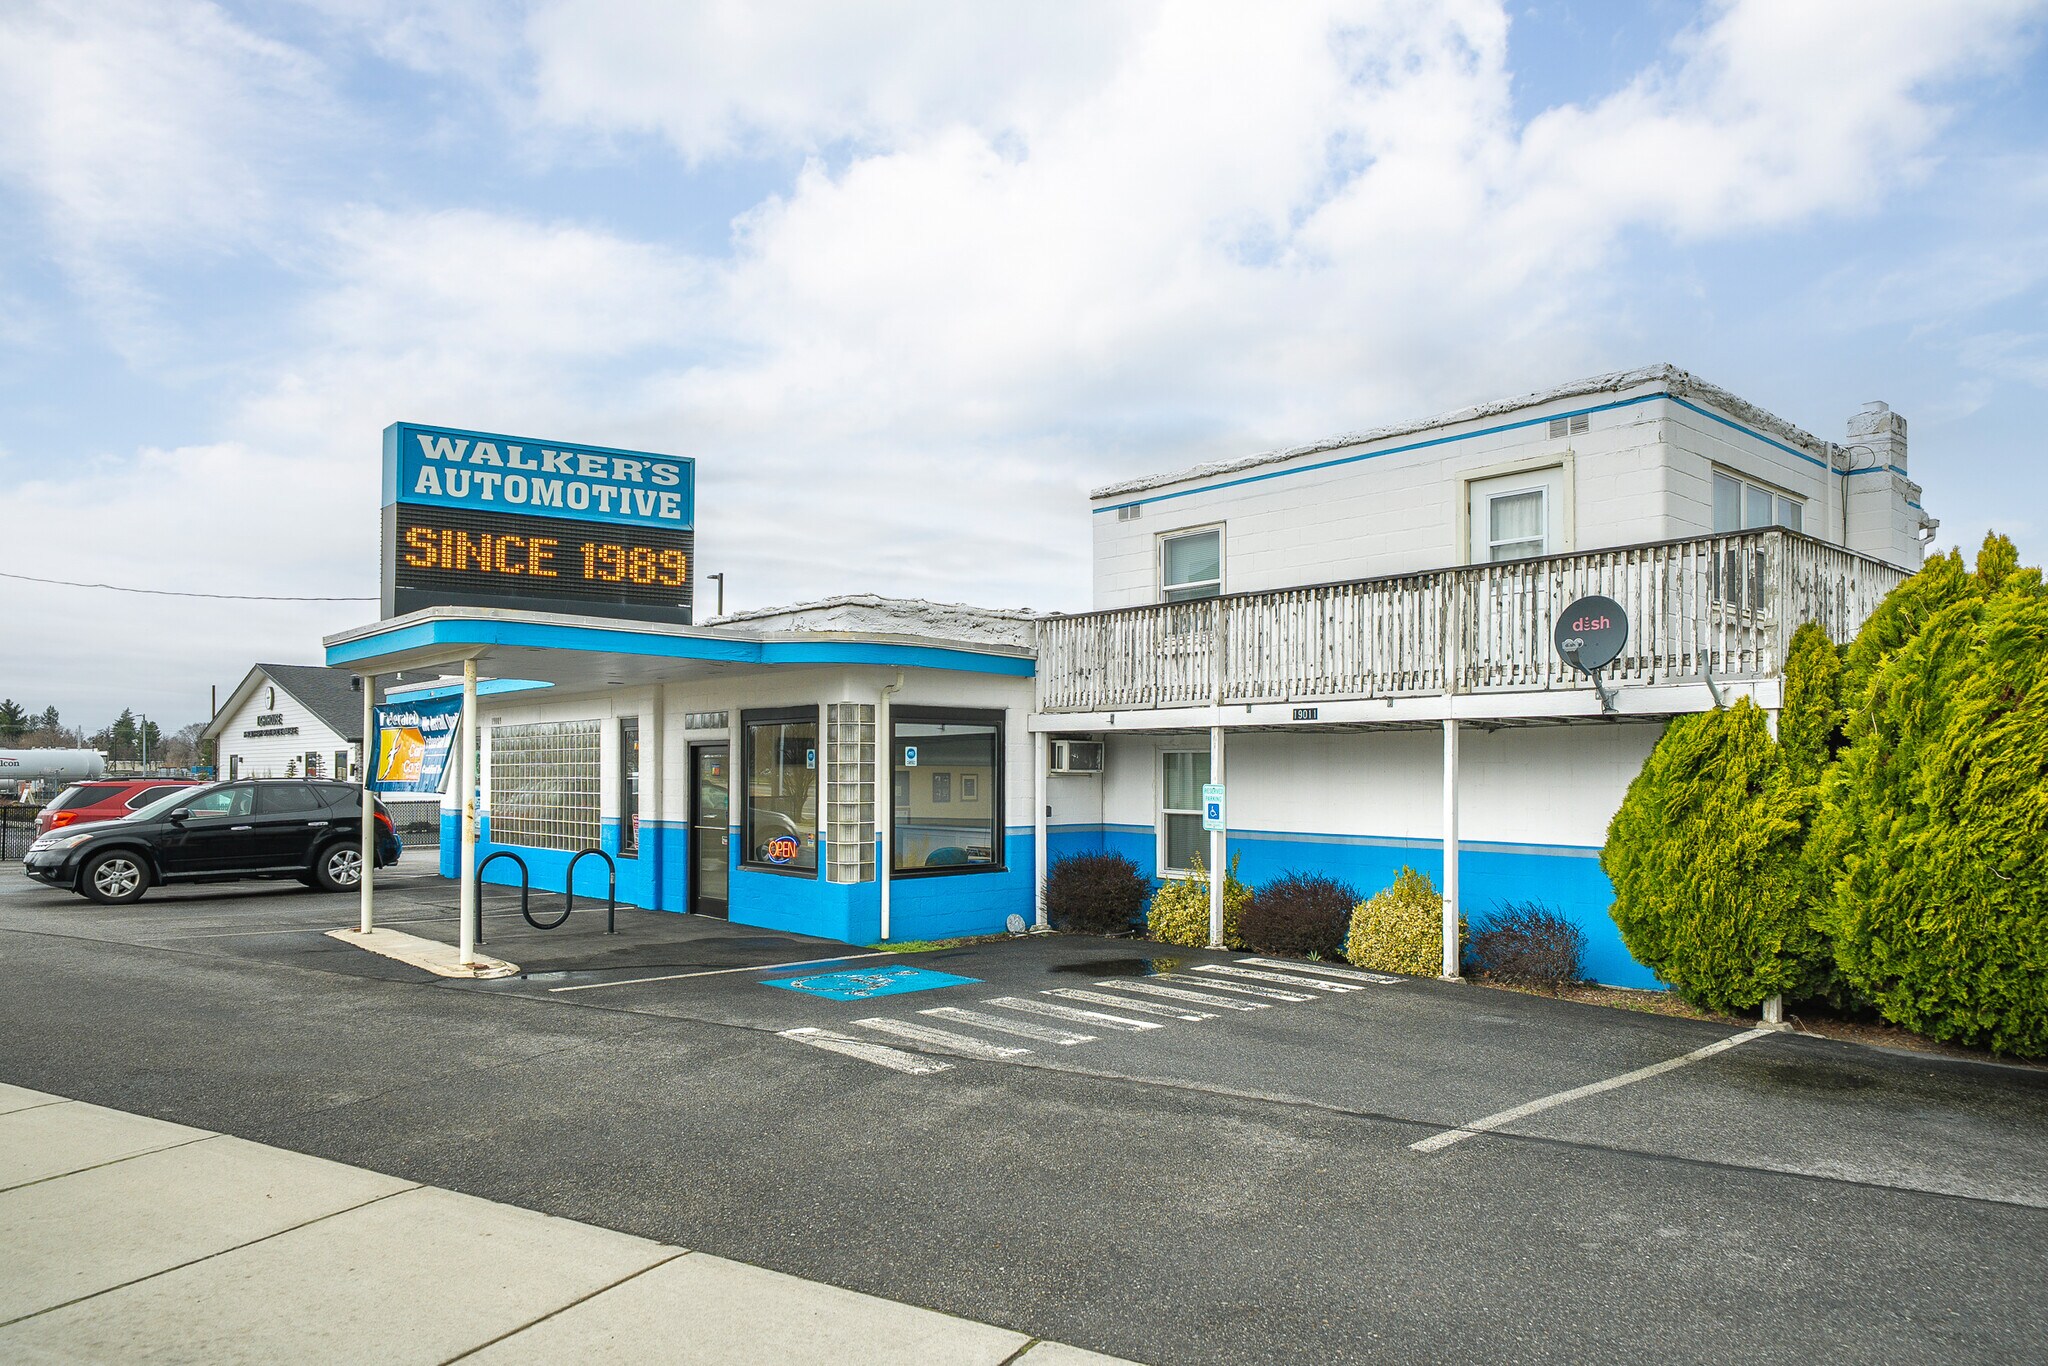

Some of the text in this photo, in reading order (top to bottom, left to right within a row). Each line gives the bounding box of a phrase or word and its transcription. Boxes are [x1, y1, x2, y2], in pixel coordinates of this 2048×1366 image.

[416, 434, 681, 486] WALKER'S
[414, 465, 682, 520] AUTOMOTIVE
[405, 527, 687, 587] SINCE 1989
[1572, 615, 1611, 631] dish
[379, 710, 420, 727] Federated
[1294, 709, 1317, 720] 19011
[408, 743, 424, 758] Car
[403, 759, 421, 773] Care
[1204, 787, 1224, 795] RESERVED
[768, 840, 797, 859] OPEN
